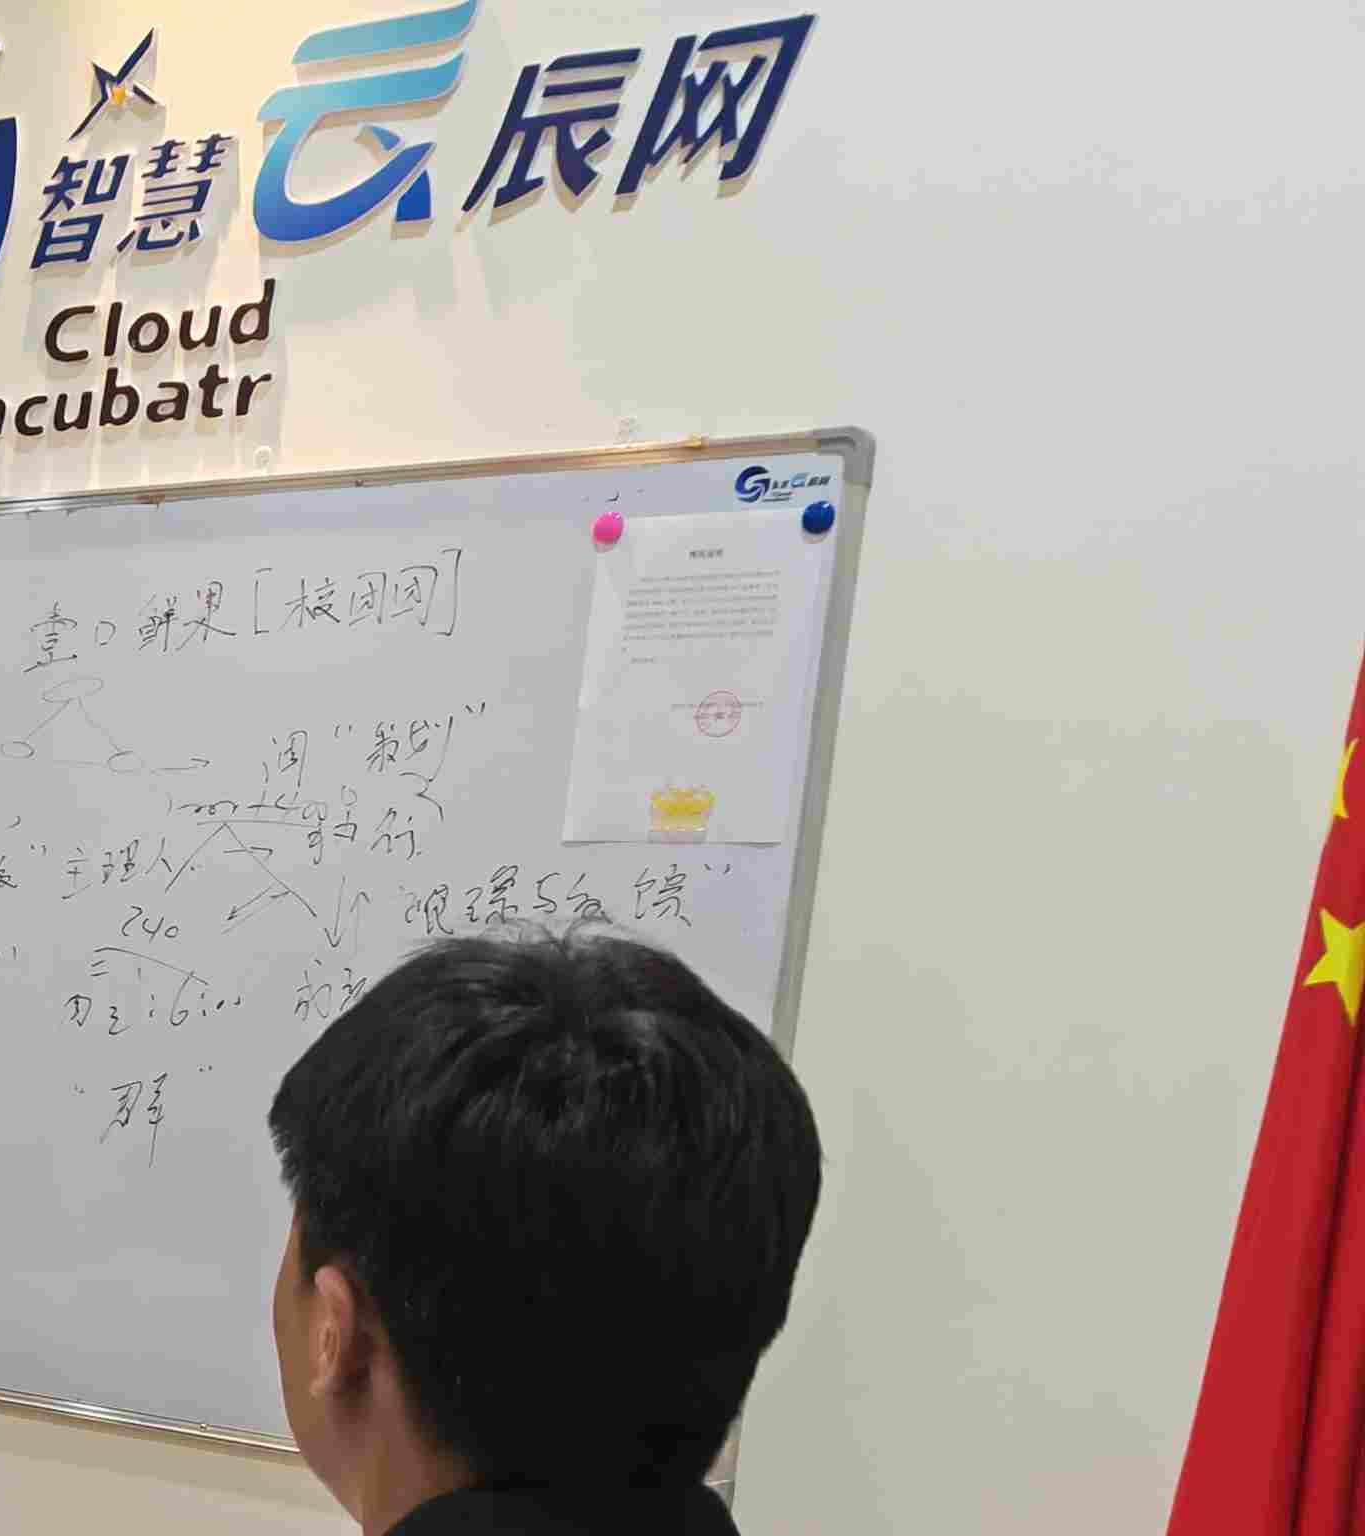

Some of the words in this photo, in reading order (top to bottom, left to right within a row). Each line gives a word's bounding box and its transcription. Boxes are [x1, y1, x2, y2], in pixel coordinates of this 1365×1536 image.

[30, 133, 231, 270] 智慧
[254, 0, 815, 244] 云辰网
[44, 277, 276, 362] Cloud
[121, 905, 179, 943] 240
